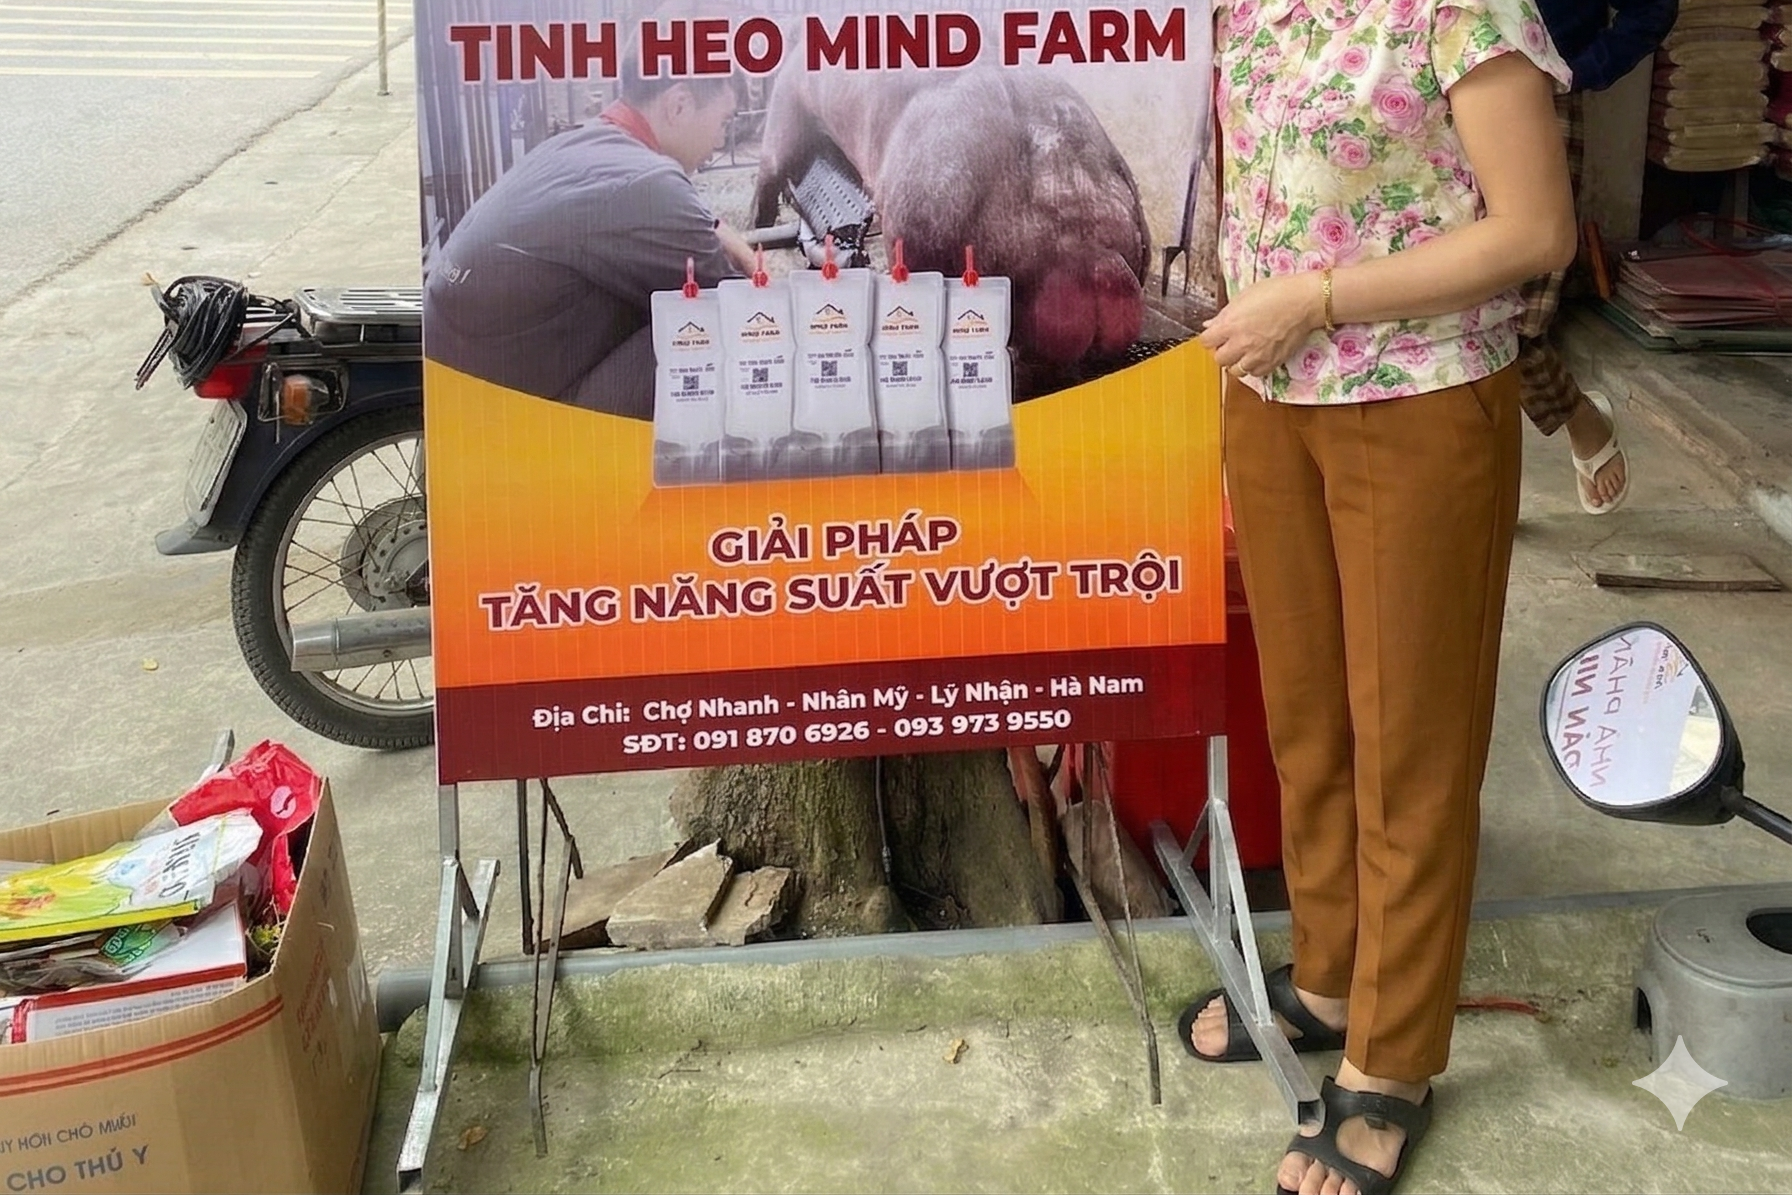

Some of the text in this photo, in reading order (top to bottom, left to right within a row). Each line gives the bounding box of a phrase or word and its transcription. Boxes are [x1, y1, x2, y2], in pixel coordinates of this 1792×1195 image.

[450, 8, 1185, 81] TINH HEO MIND FARM
[712, 513, 958, 563] GIẢI PHÁP
[482, 552, 1179, 628] TĂNG NĂNG SUẤT VƯỢT TRỘI
[533, 706, 575, 731] Địa
[643, 699, 692, 724] Chợ
[699, 694, 778, 719] Nhanh
[802, 689, 866, 711] Nhân
[873, 685, 909, 710] Mỹ
[965, 679, 1028, 705] Nhận
[1050, 674, 1081, 697] Hà
[1089, 676, 1144, 695] Nam
[623, 732, 686, 754] SĐT:
[693, 729, 738, 750] 091
[746, 725, 797, 748] 870
[804, 721, 870, 743] 6926
[894, 716, 944, 738] 093
[952, 713, 999, 734] 973
[1006, 709, 1072, 730] 9550
[7, 1165, 67, 1191] CHO
[132, 1144, 149, 1165] Y
